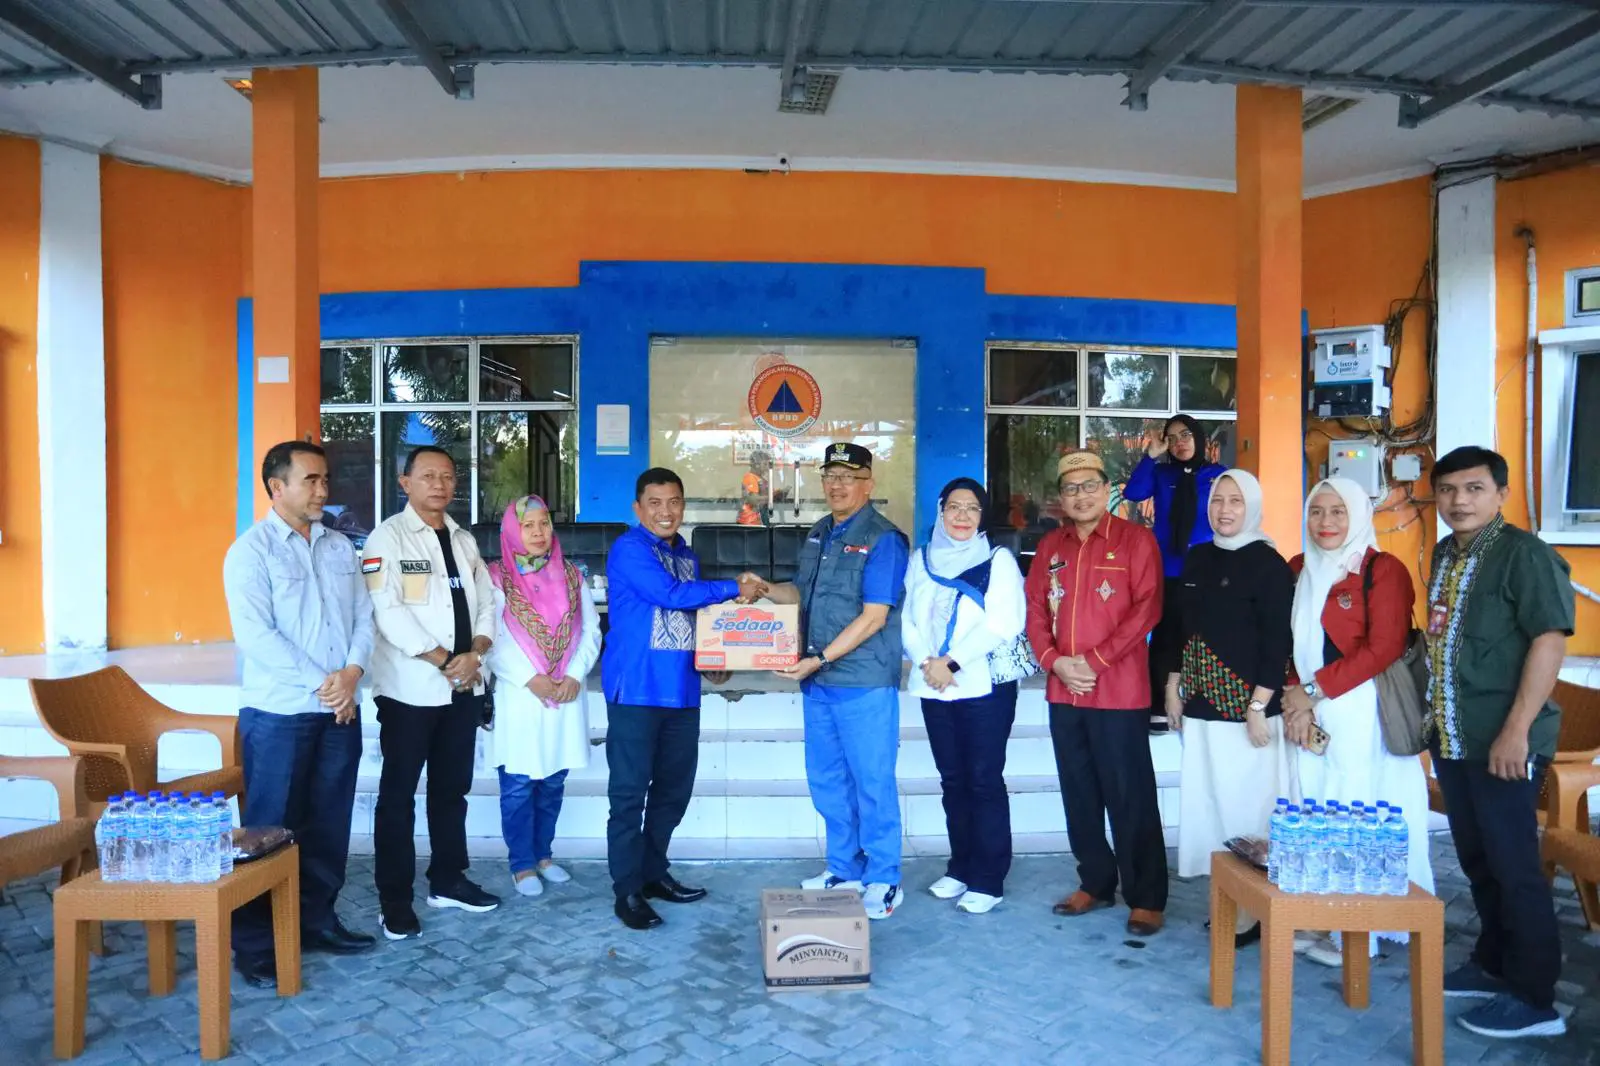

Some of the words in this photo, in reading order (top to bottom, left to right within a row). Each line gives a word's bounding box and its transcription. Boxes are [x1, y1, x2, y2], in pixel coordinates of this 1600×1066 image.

[403, 562, 428, 571] NASLI
[712, 618, 783, 634] Sedaap
[759, 656, 795, 665] GORENG
[789, 948, 848, 964] MINYAKITA
